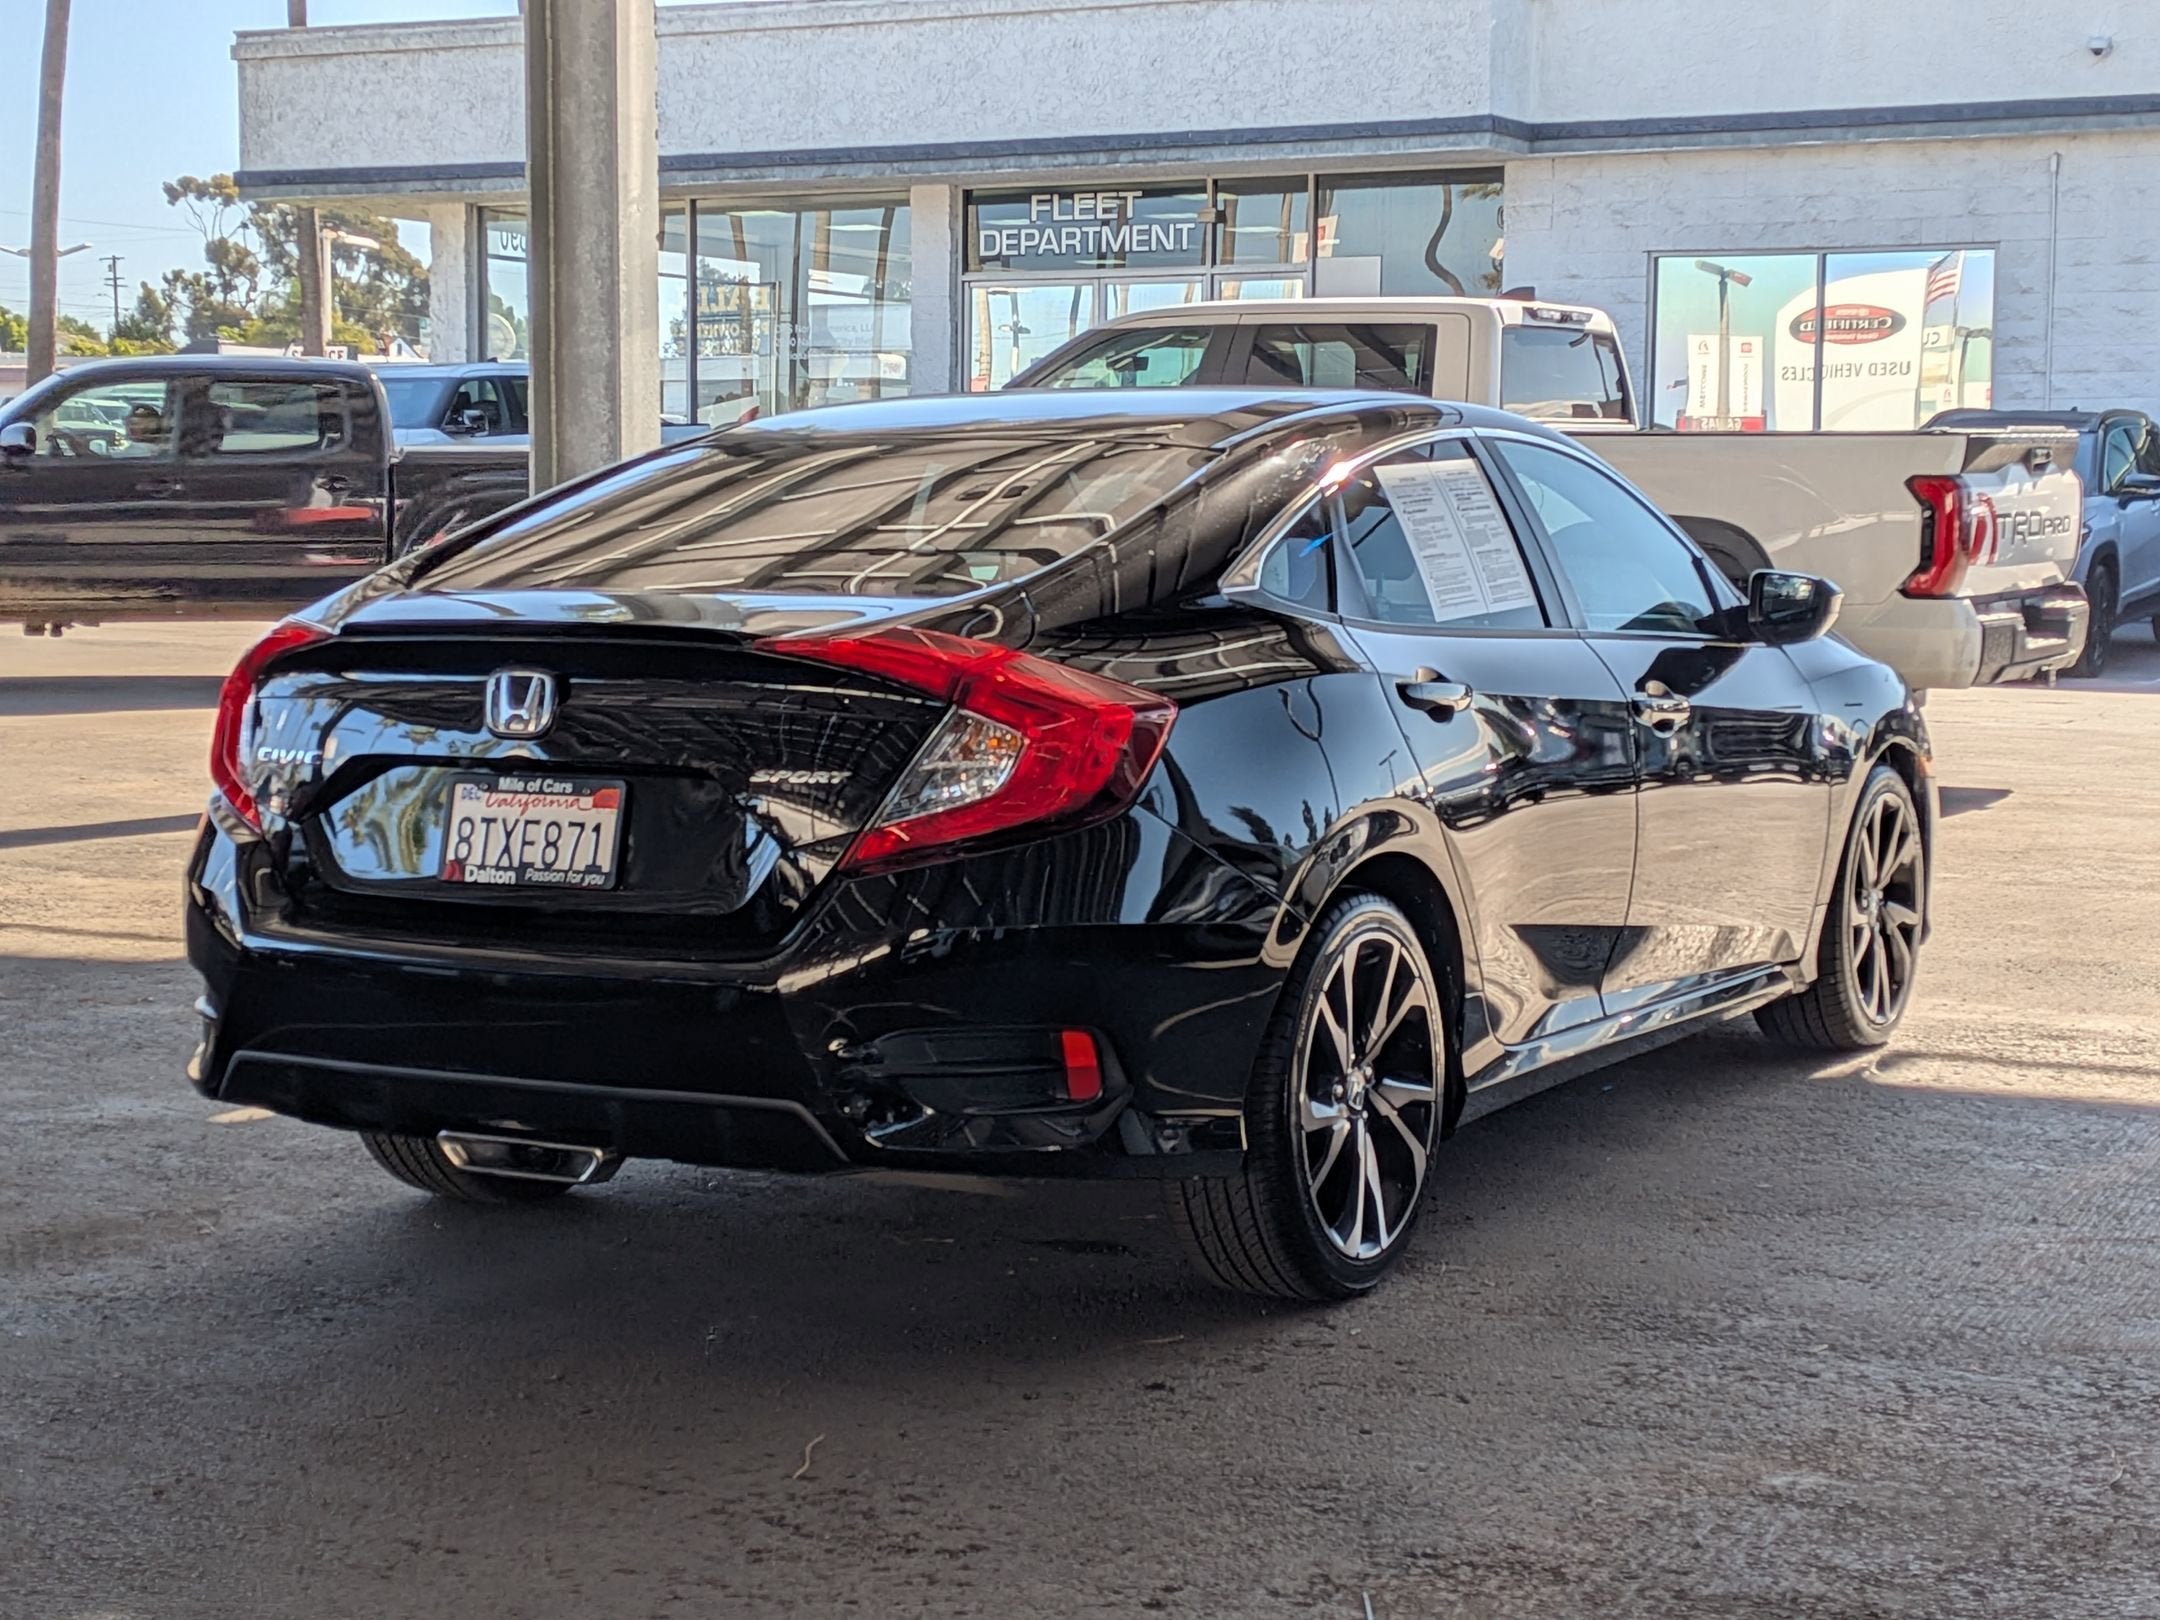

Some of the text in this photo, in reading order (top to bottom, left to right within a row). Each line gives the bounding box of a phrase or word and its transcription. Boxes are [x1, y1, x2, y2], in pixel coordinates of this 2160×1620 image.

[1031, 190, 1143, 222] FLEET
[979, 223, 1196, 257] DEPARTMENT
[1996, 510, 2071, 545] TRD PRO
[257, 746, 323, 765] CIVIC
[498, 777, 573, 794] Mile of Cars
[749, 769, 852, 784] SPORT
[484, 791, 593, 817] California
[454, 816, 602, 870] 8TXE871
[464, 865, 605, 886] Dalton Passion for you
